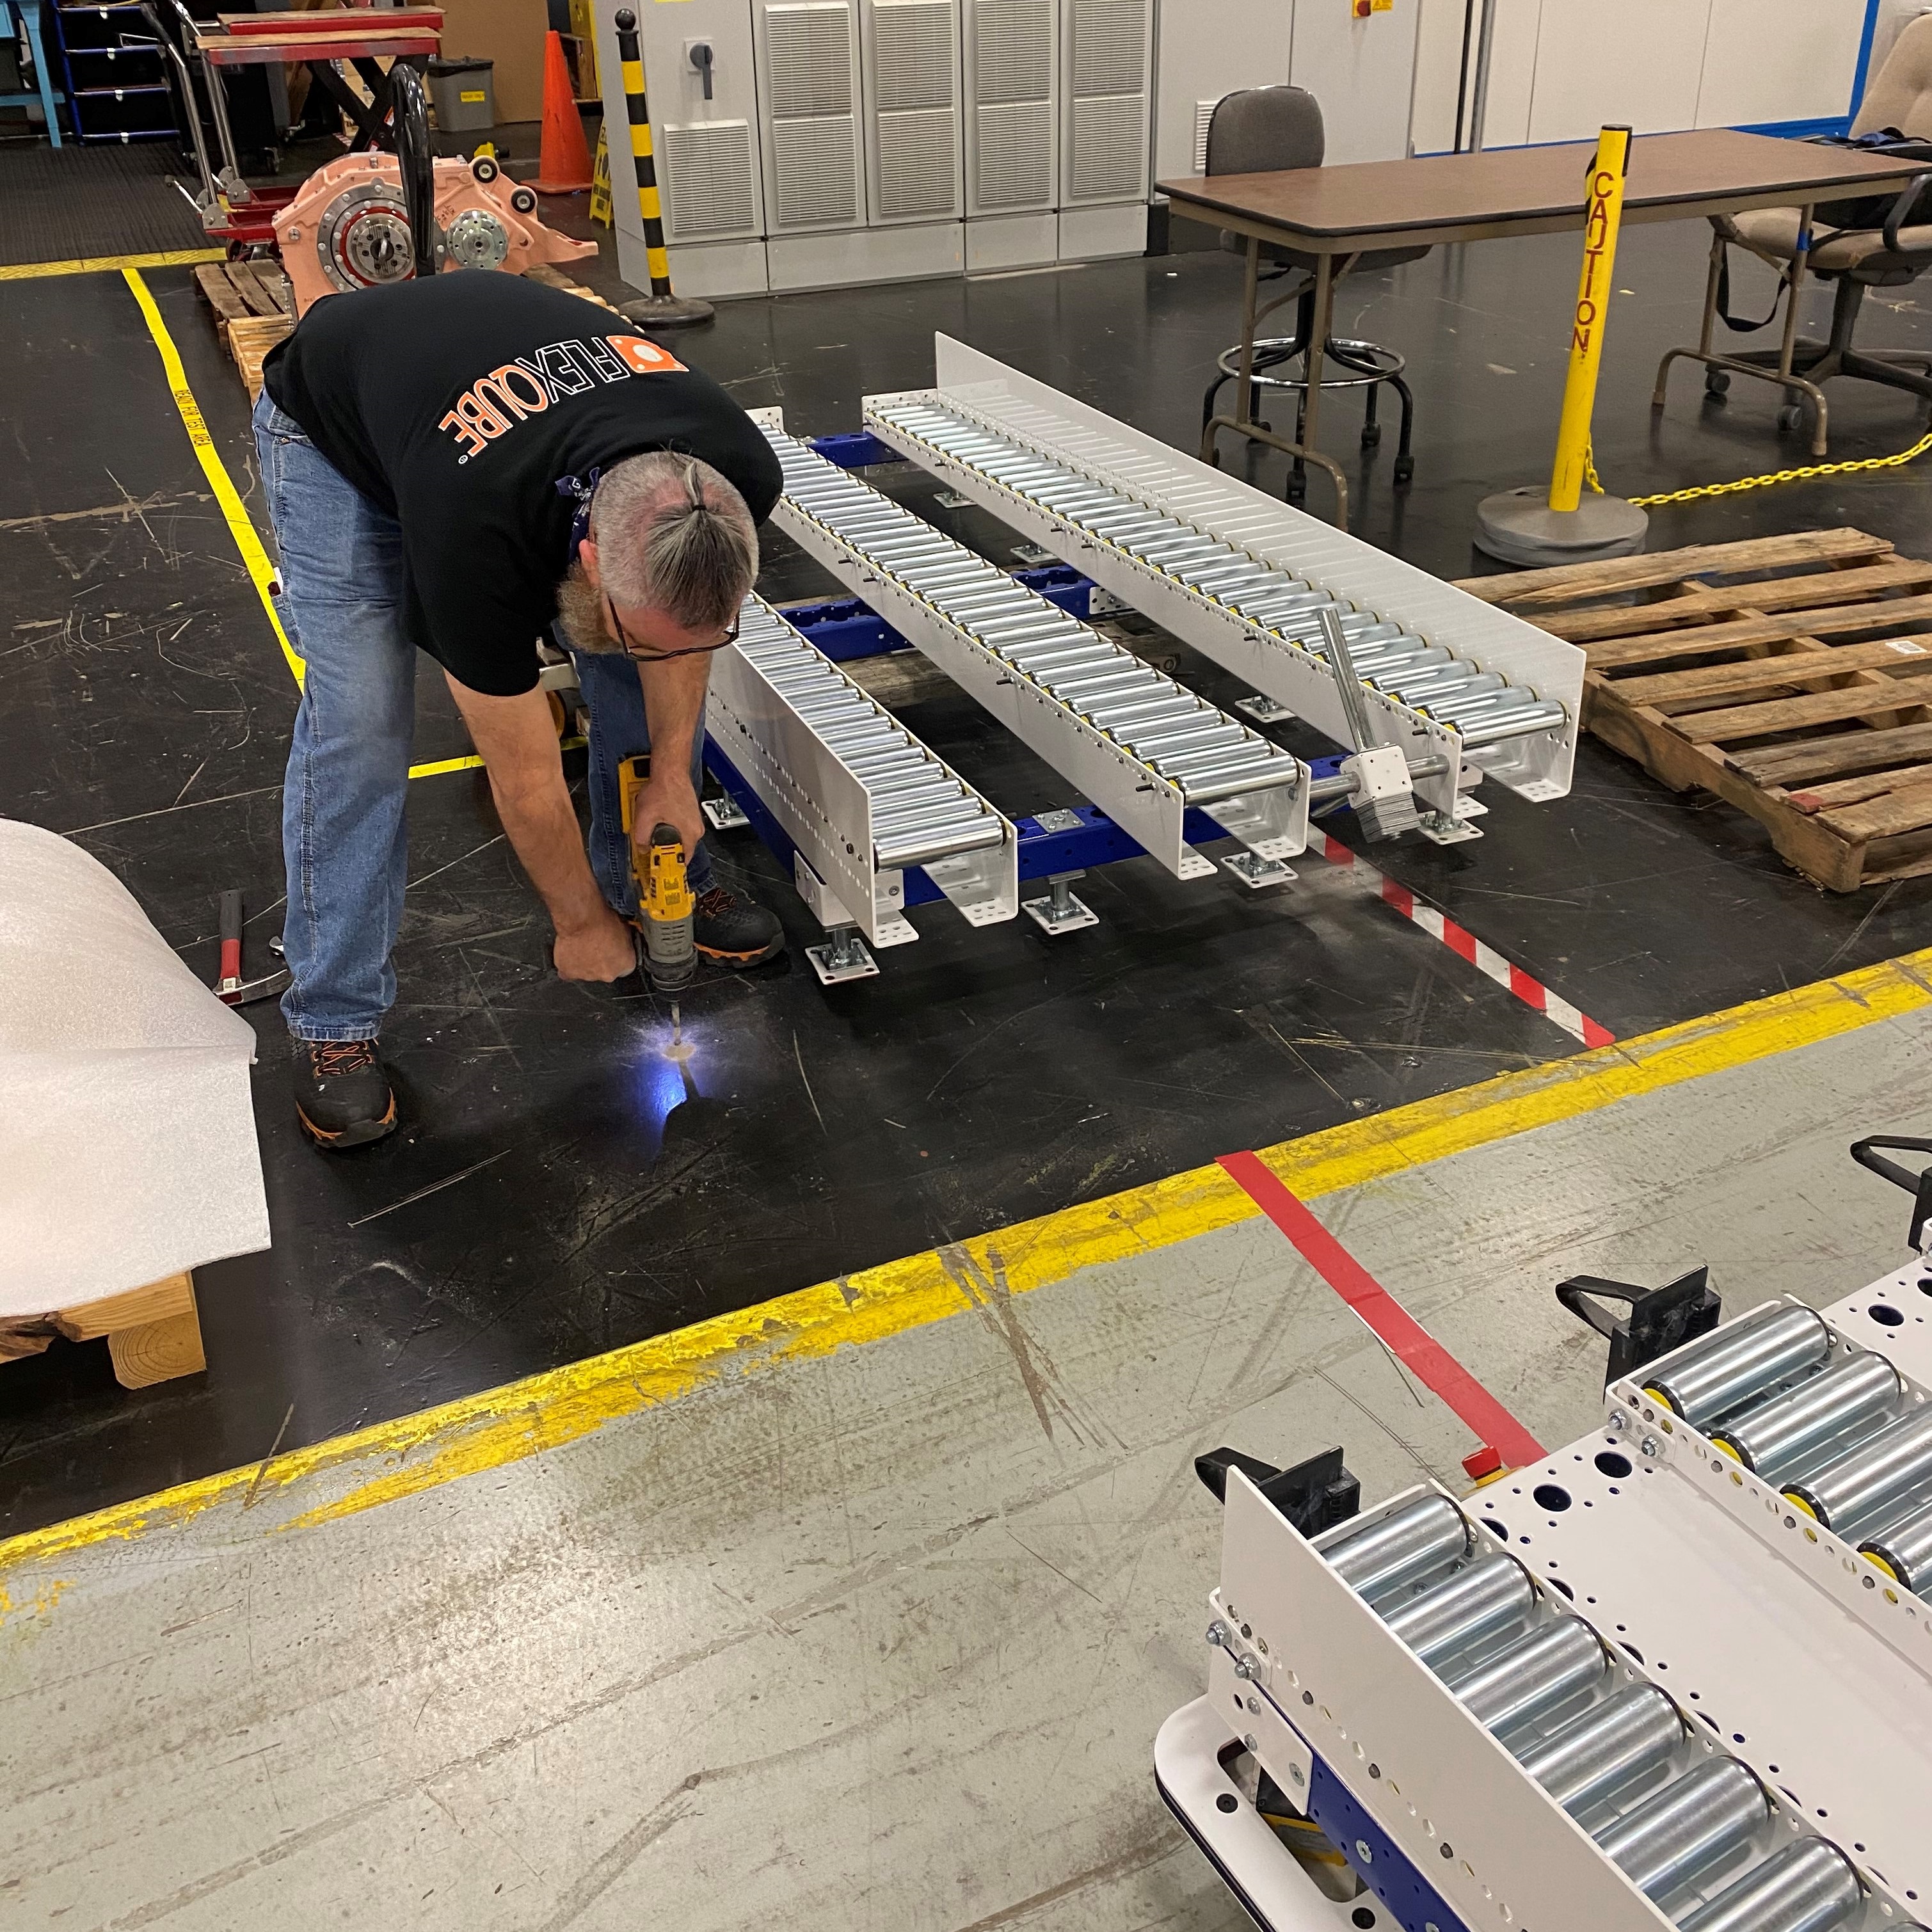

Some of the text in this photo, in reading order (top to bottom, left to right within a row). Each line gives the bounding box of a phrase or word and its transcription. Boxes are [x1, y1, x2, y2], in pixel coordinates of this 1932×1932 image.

[1572, 172, 1614, 353] CAUTION
[438, 337, 631, 458] FLEXQUBE
[180, 406, 200, 417] FOR
[185, 417, 206, 430] TEST
[190, 433, 212, 447] AREA
